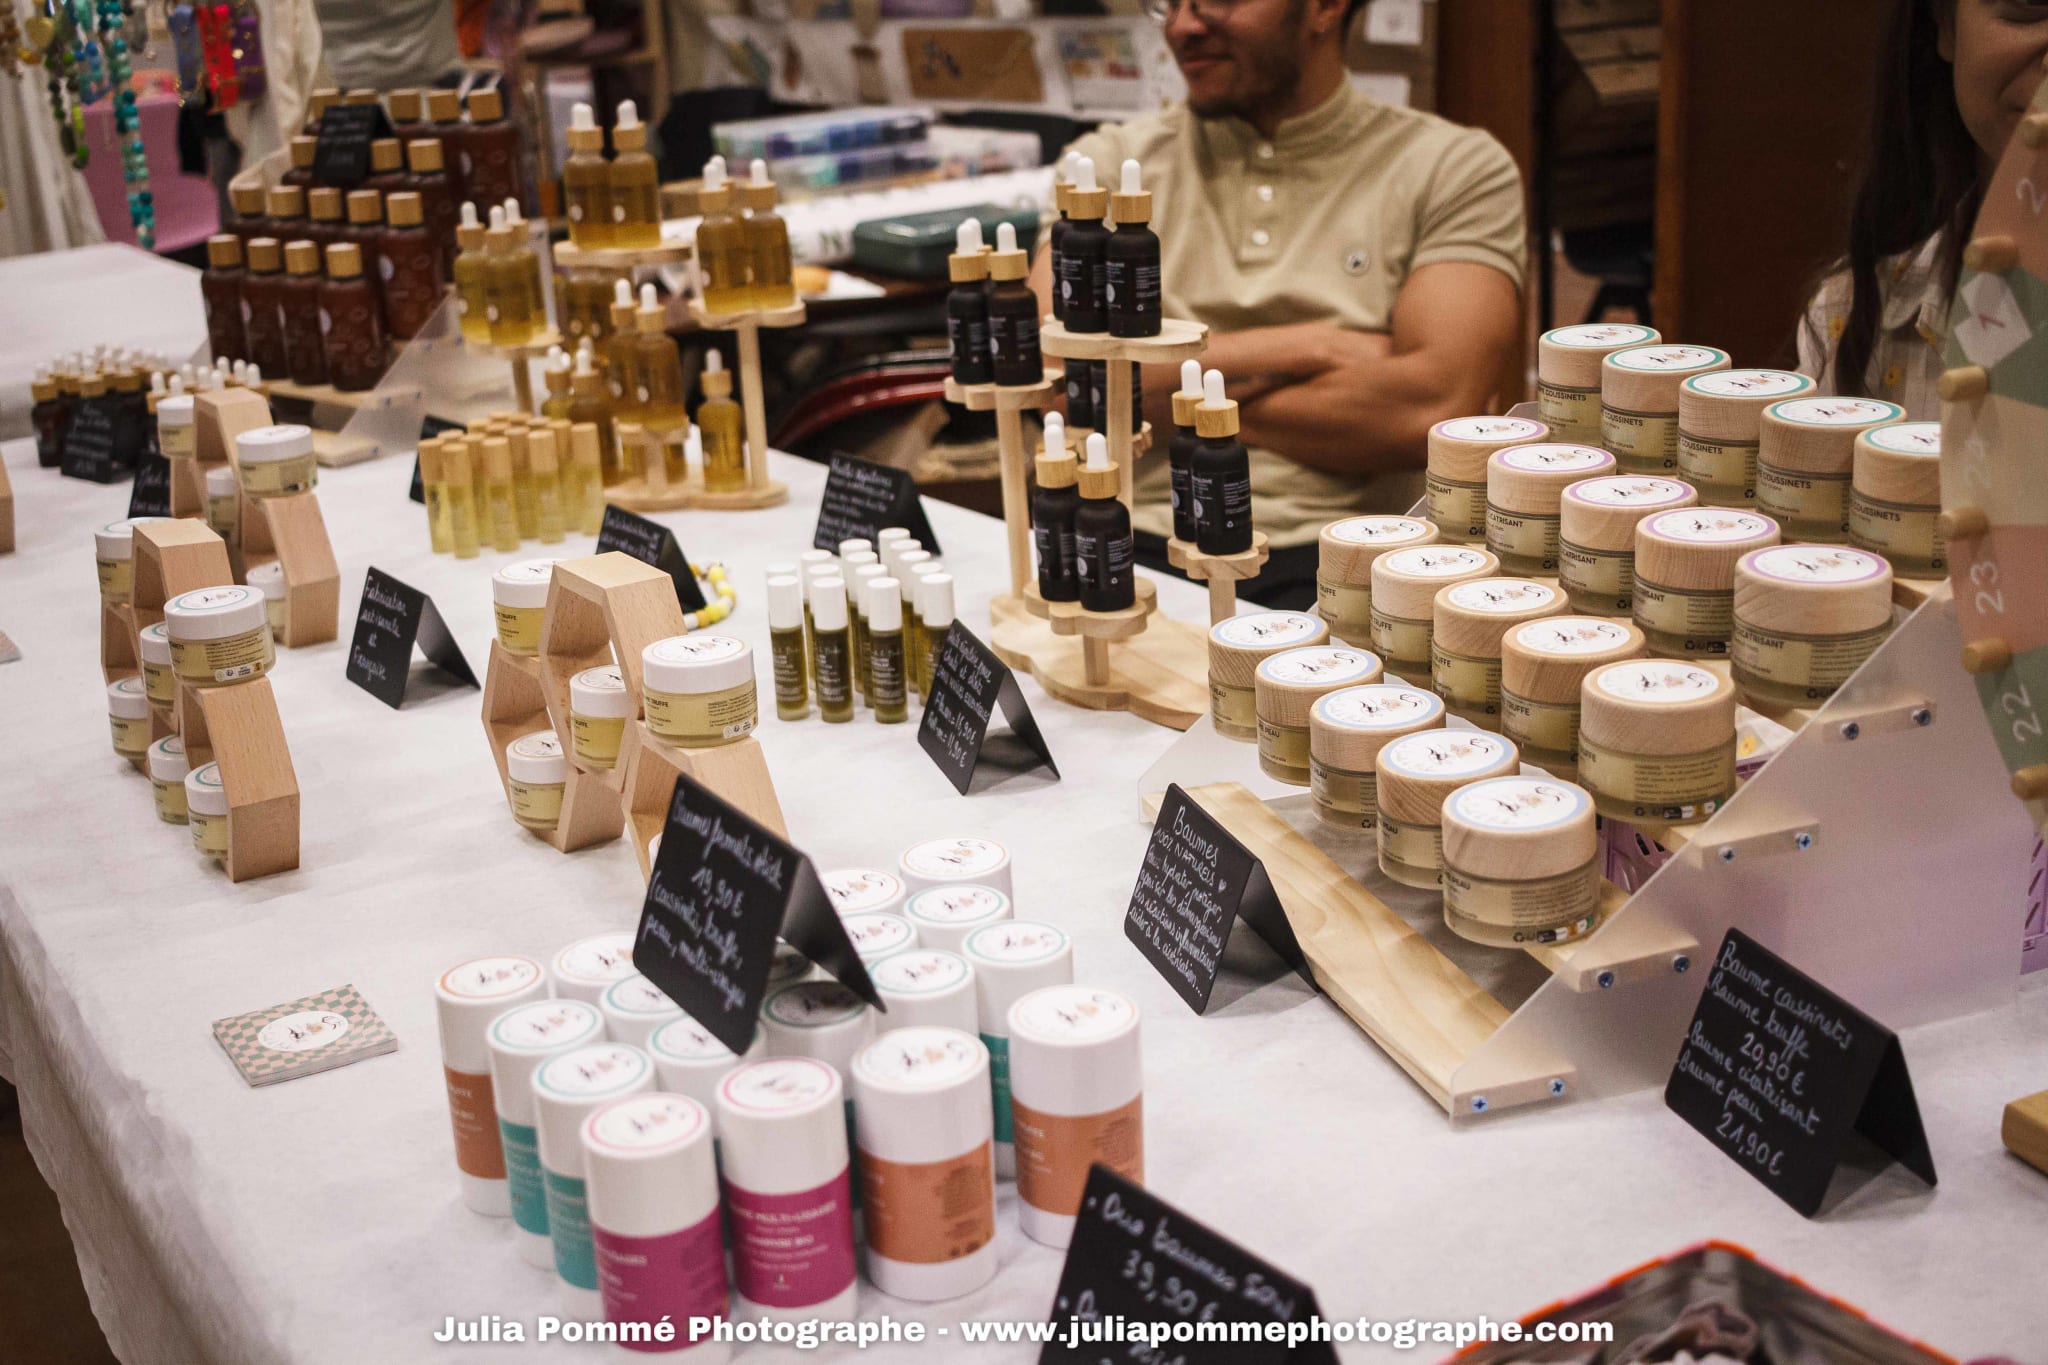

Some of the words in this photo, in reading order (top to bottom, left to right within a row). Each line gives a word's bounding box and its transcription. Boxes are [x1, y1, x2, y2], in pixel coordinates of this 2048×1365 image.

[1603, 410, 1644, 427] COUSSINETS
[1682, 439, 1723, 455] COUSSINETS
[1763, 472, 1812, 489] COUSSINETS
[1971, 560, 2000, 615] 23
[1264, 726, 1280, 738] PEAU
[2001, 682, 2042, 744] 22
[1154, 827, 1174, 854] 100%
[1173, 805, 1219, 867] Baumes
[1719, 940, 1770, 998] Baume
[1711, 972, 1761, 1024] Baume
[1764, 1012, 1810, 1062] truffe
[1679, 1049, 1724, 1097] Baume
[1725, 1088, 1764, 1123] peau
[1690, 1020, 1733, 1073] Baume
[1737, 1061, 1821, 1135] cicatrisant
